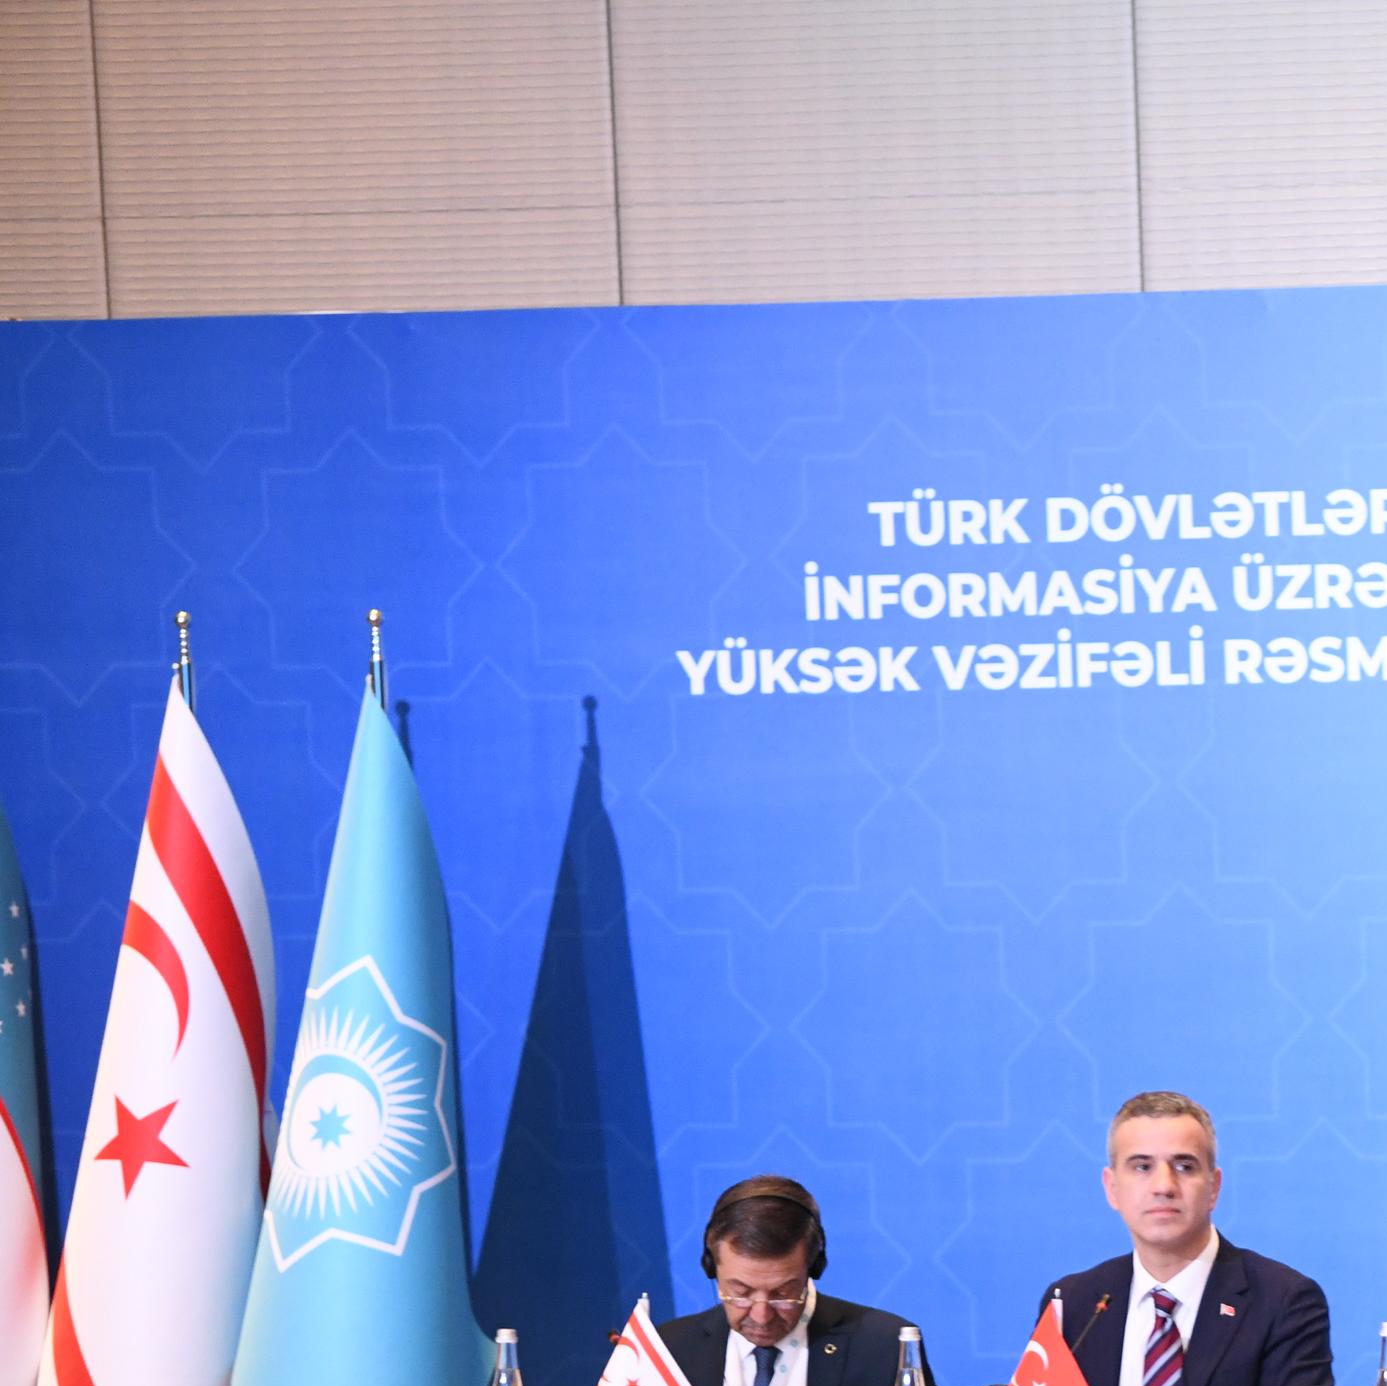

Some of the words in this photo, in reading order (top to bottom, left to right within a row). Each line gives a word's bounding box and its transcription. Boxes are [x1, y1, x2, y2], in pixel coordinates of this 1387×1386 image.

[868, 489, 1029, 546] TÜRK
[805, 554, 1216, 620] İNFORMASİYA
[677, 638, 919, 695] YÜKSƏK
[933, 625, 1204, 689] VƏZİFƏLİ
